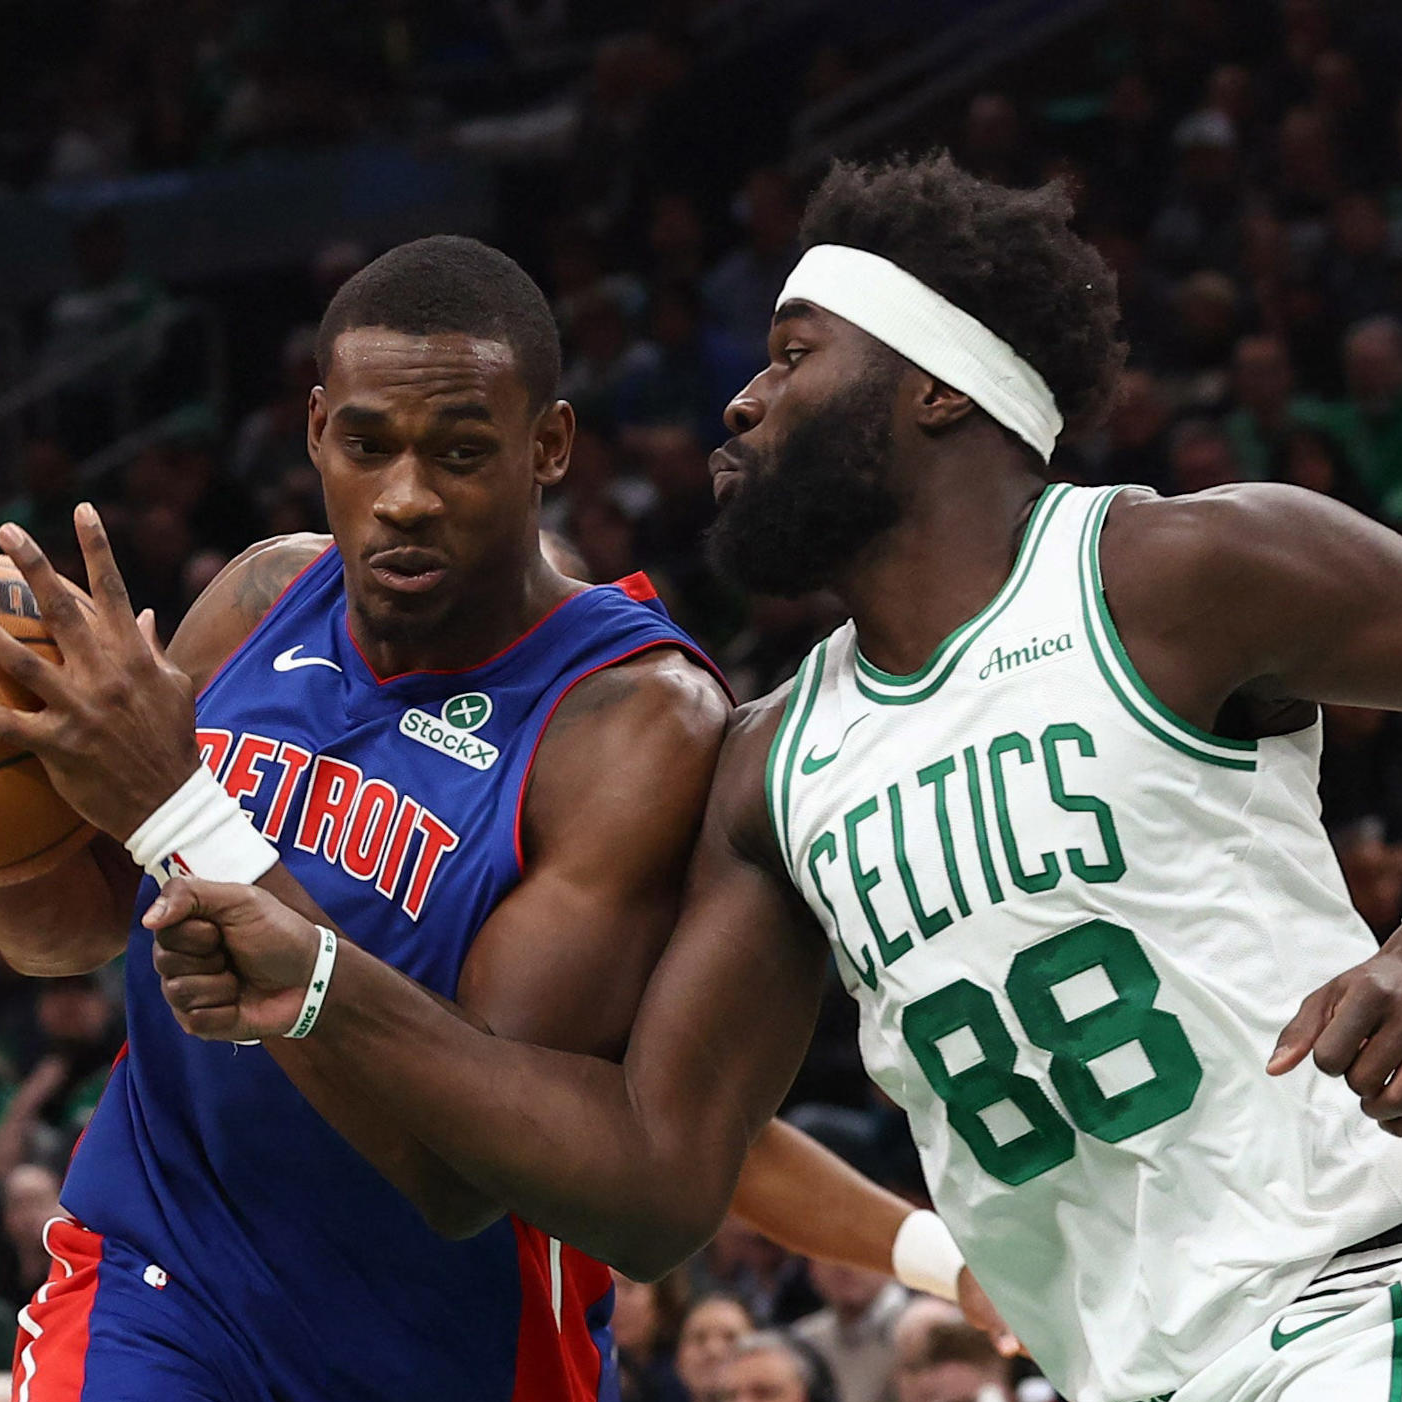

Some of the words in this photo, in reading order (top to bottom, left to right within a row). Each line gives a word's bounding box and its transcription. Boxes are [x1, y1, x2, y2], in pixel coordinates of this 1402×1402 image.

[979, 632, 1074, 681] Amica
[403, 712, 495, 767] StockX
[808, 722, 1128, 992] CELTICS
[901, 918, 1203, 1187] 88
